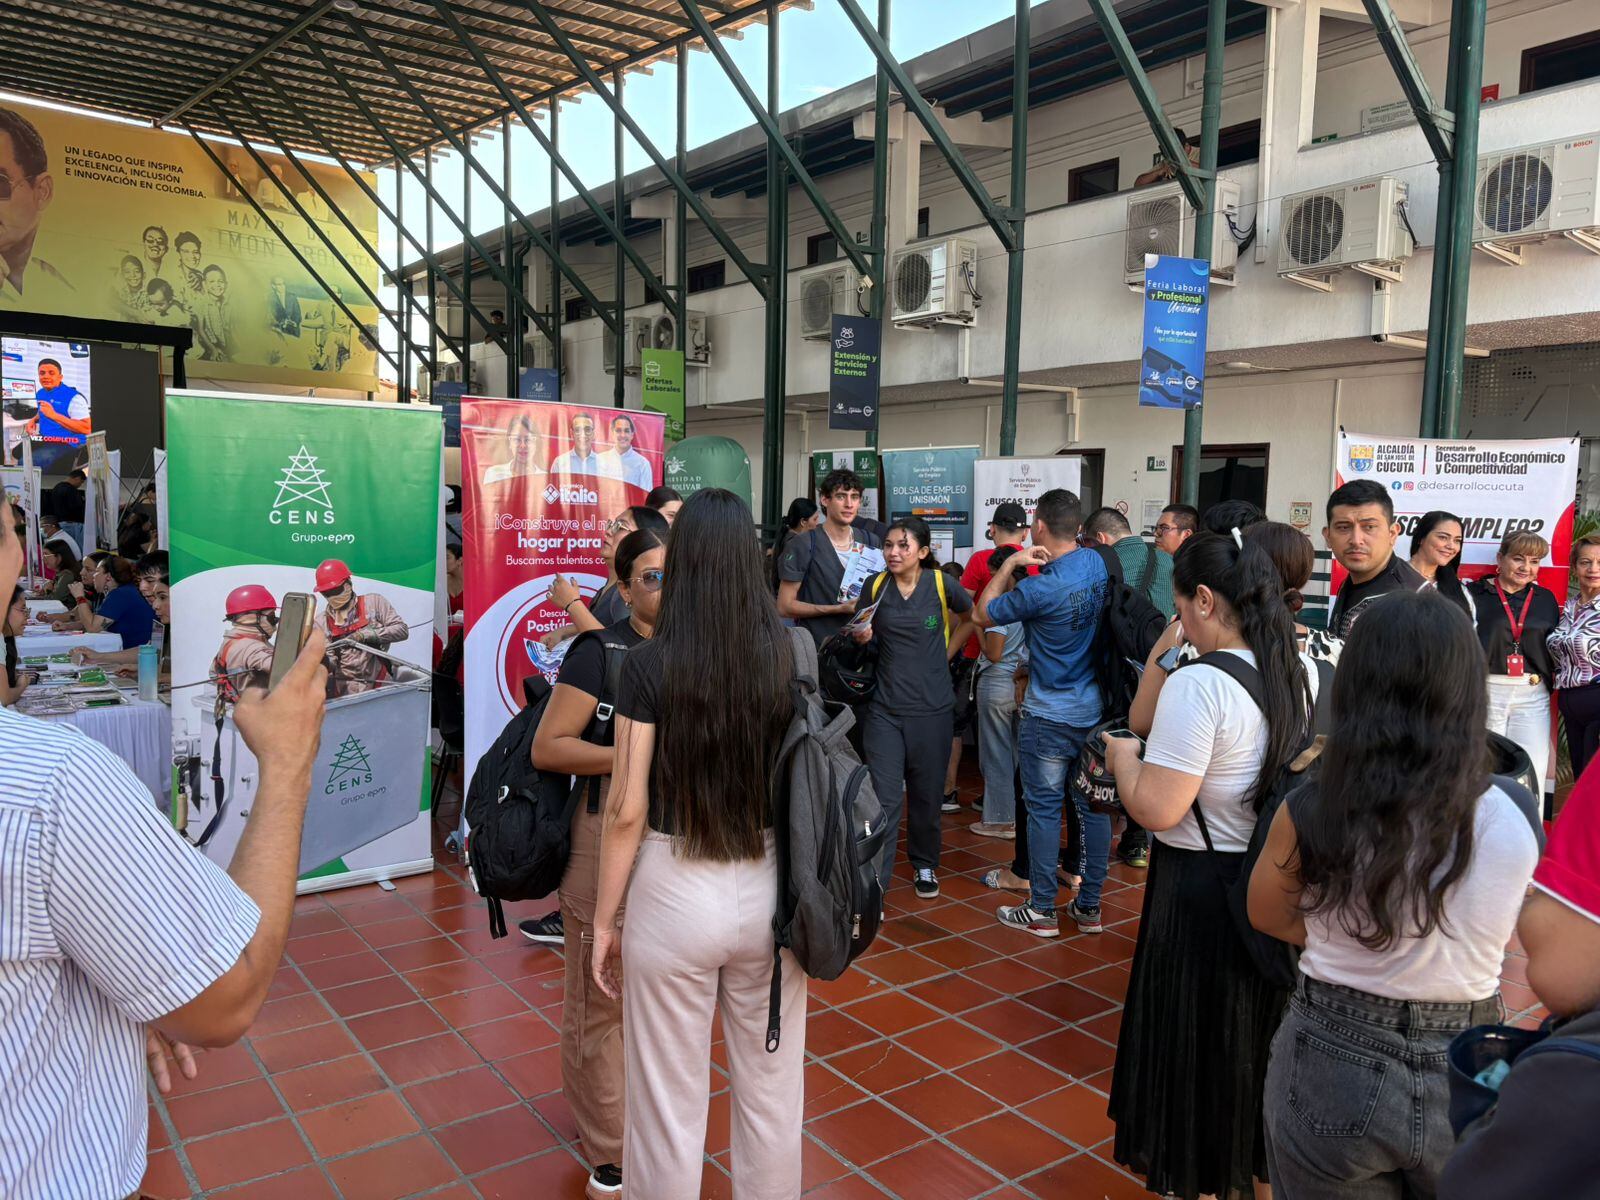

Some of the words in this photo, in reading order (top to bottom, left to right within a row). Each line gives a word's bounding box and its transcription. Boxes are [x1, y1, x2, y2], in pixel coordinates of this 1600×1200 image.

[1574, 139, 1593, 148] BOSCH
[65, 145, 80, 156] UN
[83, 149, 123, 163] LEGADO
[125, 156, 146, 167] QUE
[148, 161, 184, 174] INSPIRA
[65, 156, 128, 175] EXCELENCIA,
[130, 168, 181, 184] INCLUSIÓN
[65, 167, 72, 176] E
[74, 169, 138, 187] INNOVACIÓN
[140, 180, 153, 190] EN
[155, 183, 207, 199] COLOMBIA.
[228, 209, 285, 233] MAYR
[1147, 279, 1170, 290] Feria
[1173, 282, 1206, 293] Laboral
[1151, 292, 1156, 301] y
[1157, 291, 1202, 303] Profesional
[834, 351, 871, 361] Extensión
[871, 355, 877, 363] y
[834, 359, 867, 369] Servicios
[834, 367, 867, 377] Externos
[645, 377, 673, 386] Ofertas
[645, 384, 681, 393] Laborales
[1377, 443, 1415, 454] ALCALDÍA
[1435, 451, 1498, 463] Desarrollo
[1499, 451, 1566, 464] Económico
[1435, 464, 1442, 475] y
[1444, 462, 1528, 475] Competitividad
[893, 486, 921, 495] BOLSA
[921, 485, 933, 494] DE
[933, 485, 967, 495] EMPLEO
[1416, 480, 1525, 491] @desarrollocucuta
[560, 487, 598, 503] italia
[985, 497, 1023, 506] ¿BUSCAS
[269, 510, 335, 524] CENS
[494, 513, 580, 534] ¡Construye
[582, 514, 595, 530] el
[517, 532, 564, 553] hogar
[567, 537, 602, 552] para
[506, 555, 555, 565] Buscamos
[556, 555, 593, 565] talentos
[540, 609, 570, 618] Descub
[324, 772, 373, 795] CENS
[341, 793, 366, 806] Grupo
[367, 786, 387, 798] epm
